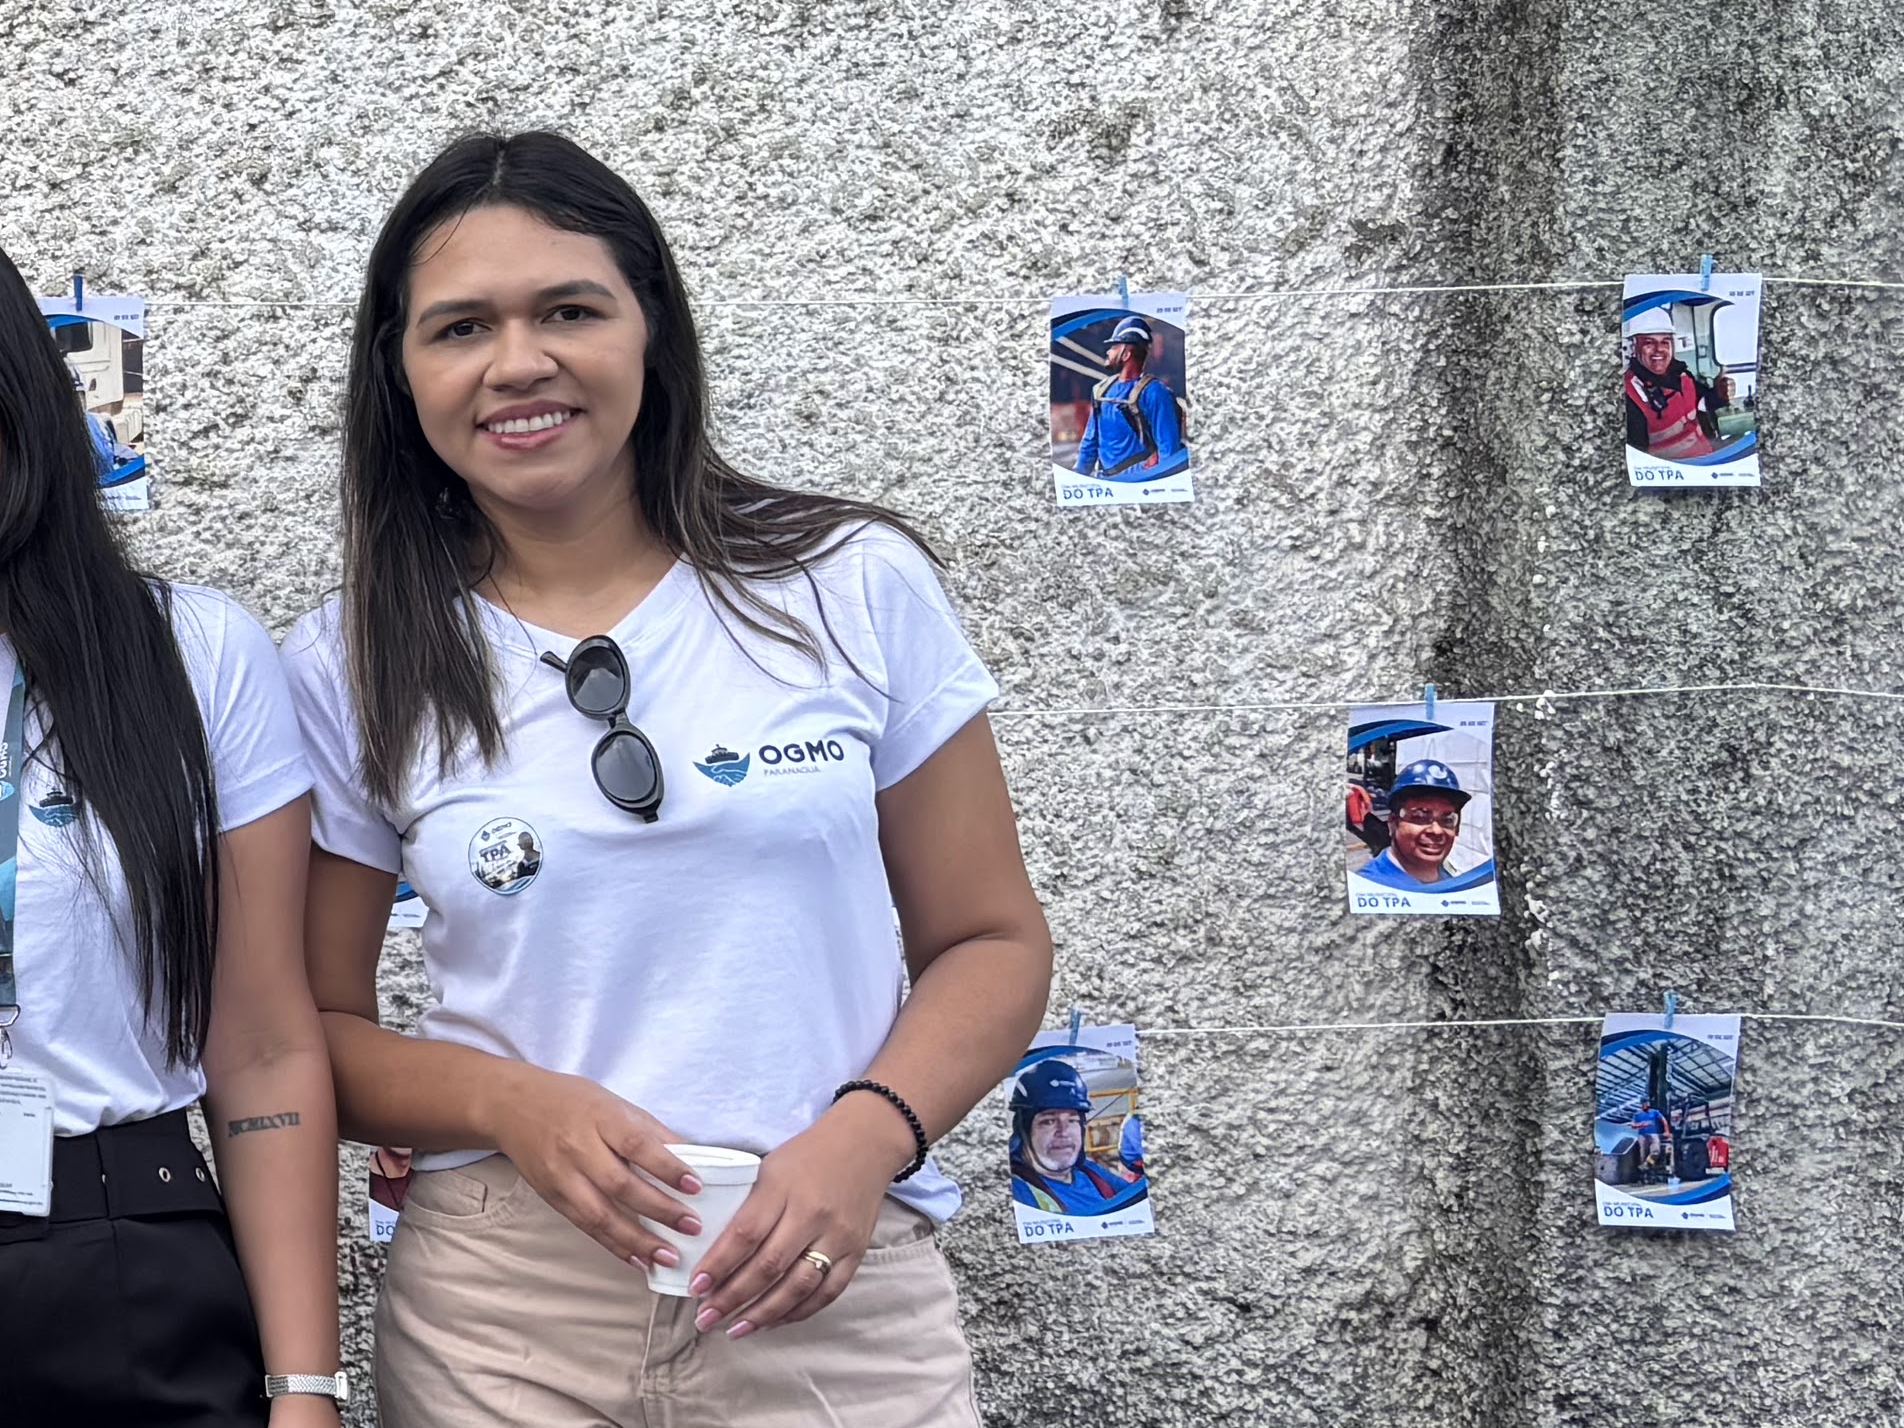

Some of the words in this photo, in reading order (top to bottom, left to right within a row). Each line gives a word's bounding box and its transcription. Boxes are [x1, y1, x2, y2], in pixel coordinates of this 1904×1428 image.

[1635, 470, 1654, 480] DO
[1660, 470, 1684, 480] TPA
[1063, 489, 1083, 499] DO
[1087, 488, 1113, 498] TPA
[759, 740, 844, 765] OGMO
[480, 844, 511, 862] TPA
[1358, 897, 1379, 907] DO
[1385, 897, 1411, 907] TPA
[1604, 1207, 1624, 1217] DO
[1628, 1207, 1653, 1218] TPA
[1025, 1226, 1044, 1237] DO
[1049, 1222, 1074, 1234] TPA
